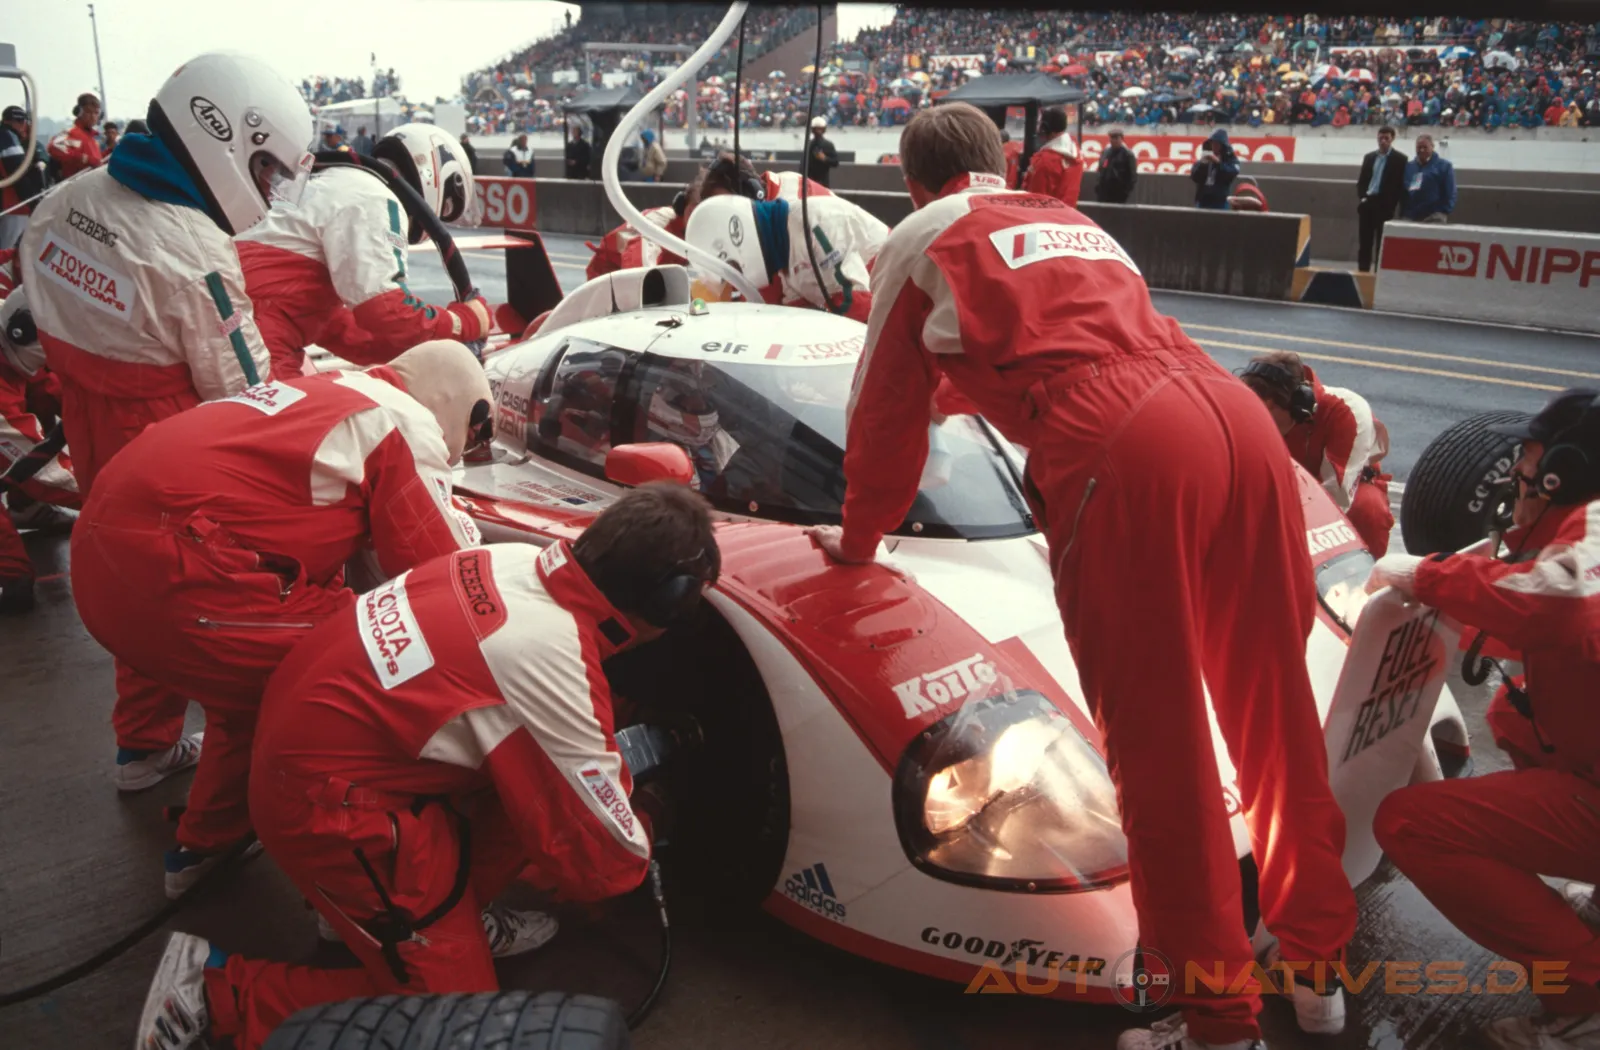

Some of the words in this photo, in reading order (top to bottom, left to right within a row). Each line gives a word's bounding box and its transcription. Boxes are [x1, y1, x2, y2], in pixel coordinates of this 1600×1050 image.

[193, 104, 231, 136] Arai
[66, 208, 119, 248] ICEBERG
[50, 261, 81, 288] TEAM
[58, 248, 118, 299] TOYOTA
[701, 340, 749, 355] elf
[501, 390, 529, 415] CASIO
[458, 553, 498, 617] ICEBERG
[376, 584, 413, 659] TOYOTA
[368, 620, 400, 677] TOM'S
[1371, 608, 1440, 693] FUEL
[1342, 657, 1439, 763] RESET
[600, 780, 634, 830] TOYOTA
[784, 878, 847, 917] adidas
[920, 926, 1107, 977] GOODYEAR
